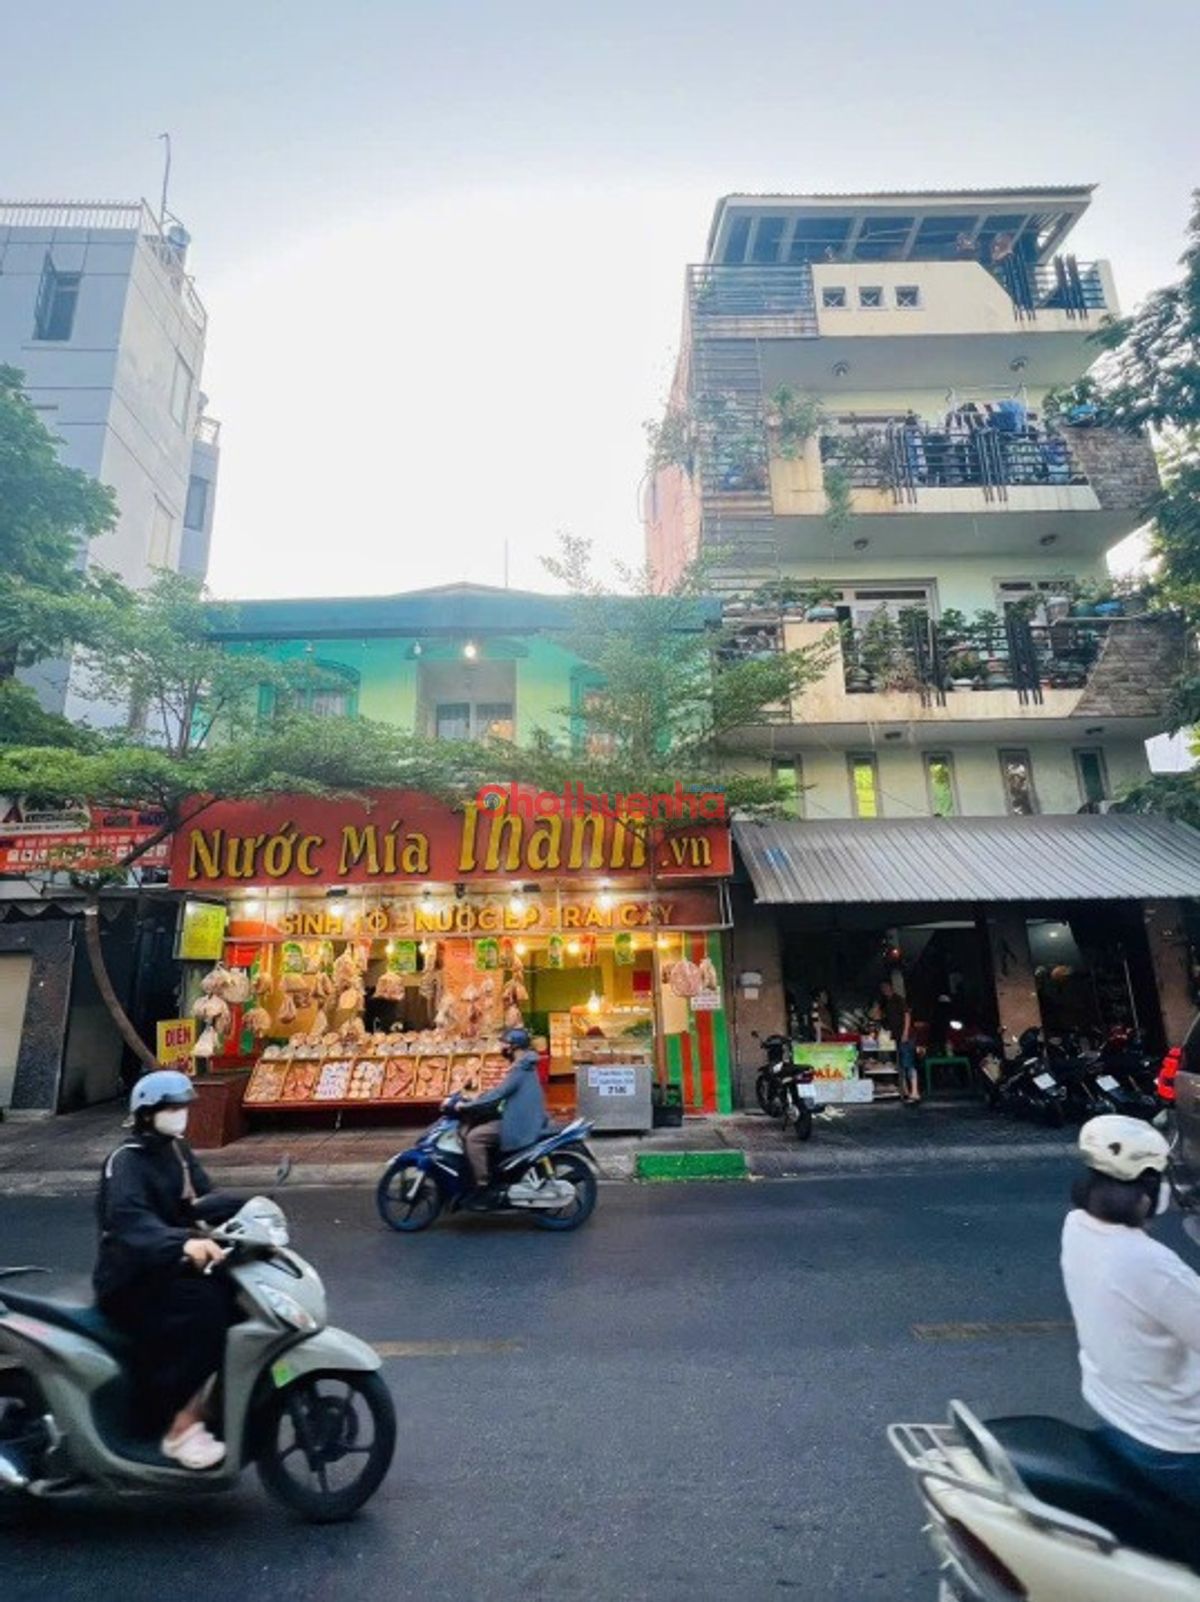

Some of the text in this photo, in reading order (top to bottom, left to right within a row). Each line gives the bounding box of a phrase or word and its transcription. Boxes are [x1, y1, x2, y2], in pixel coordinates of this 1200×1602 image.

[188, 820, 323, 879] Nước
[338, 820, 429, 875] Mía
[280, 911, 343, 934] SINH
